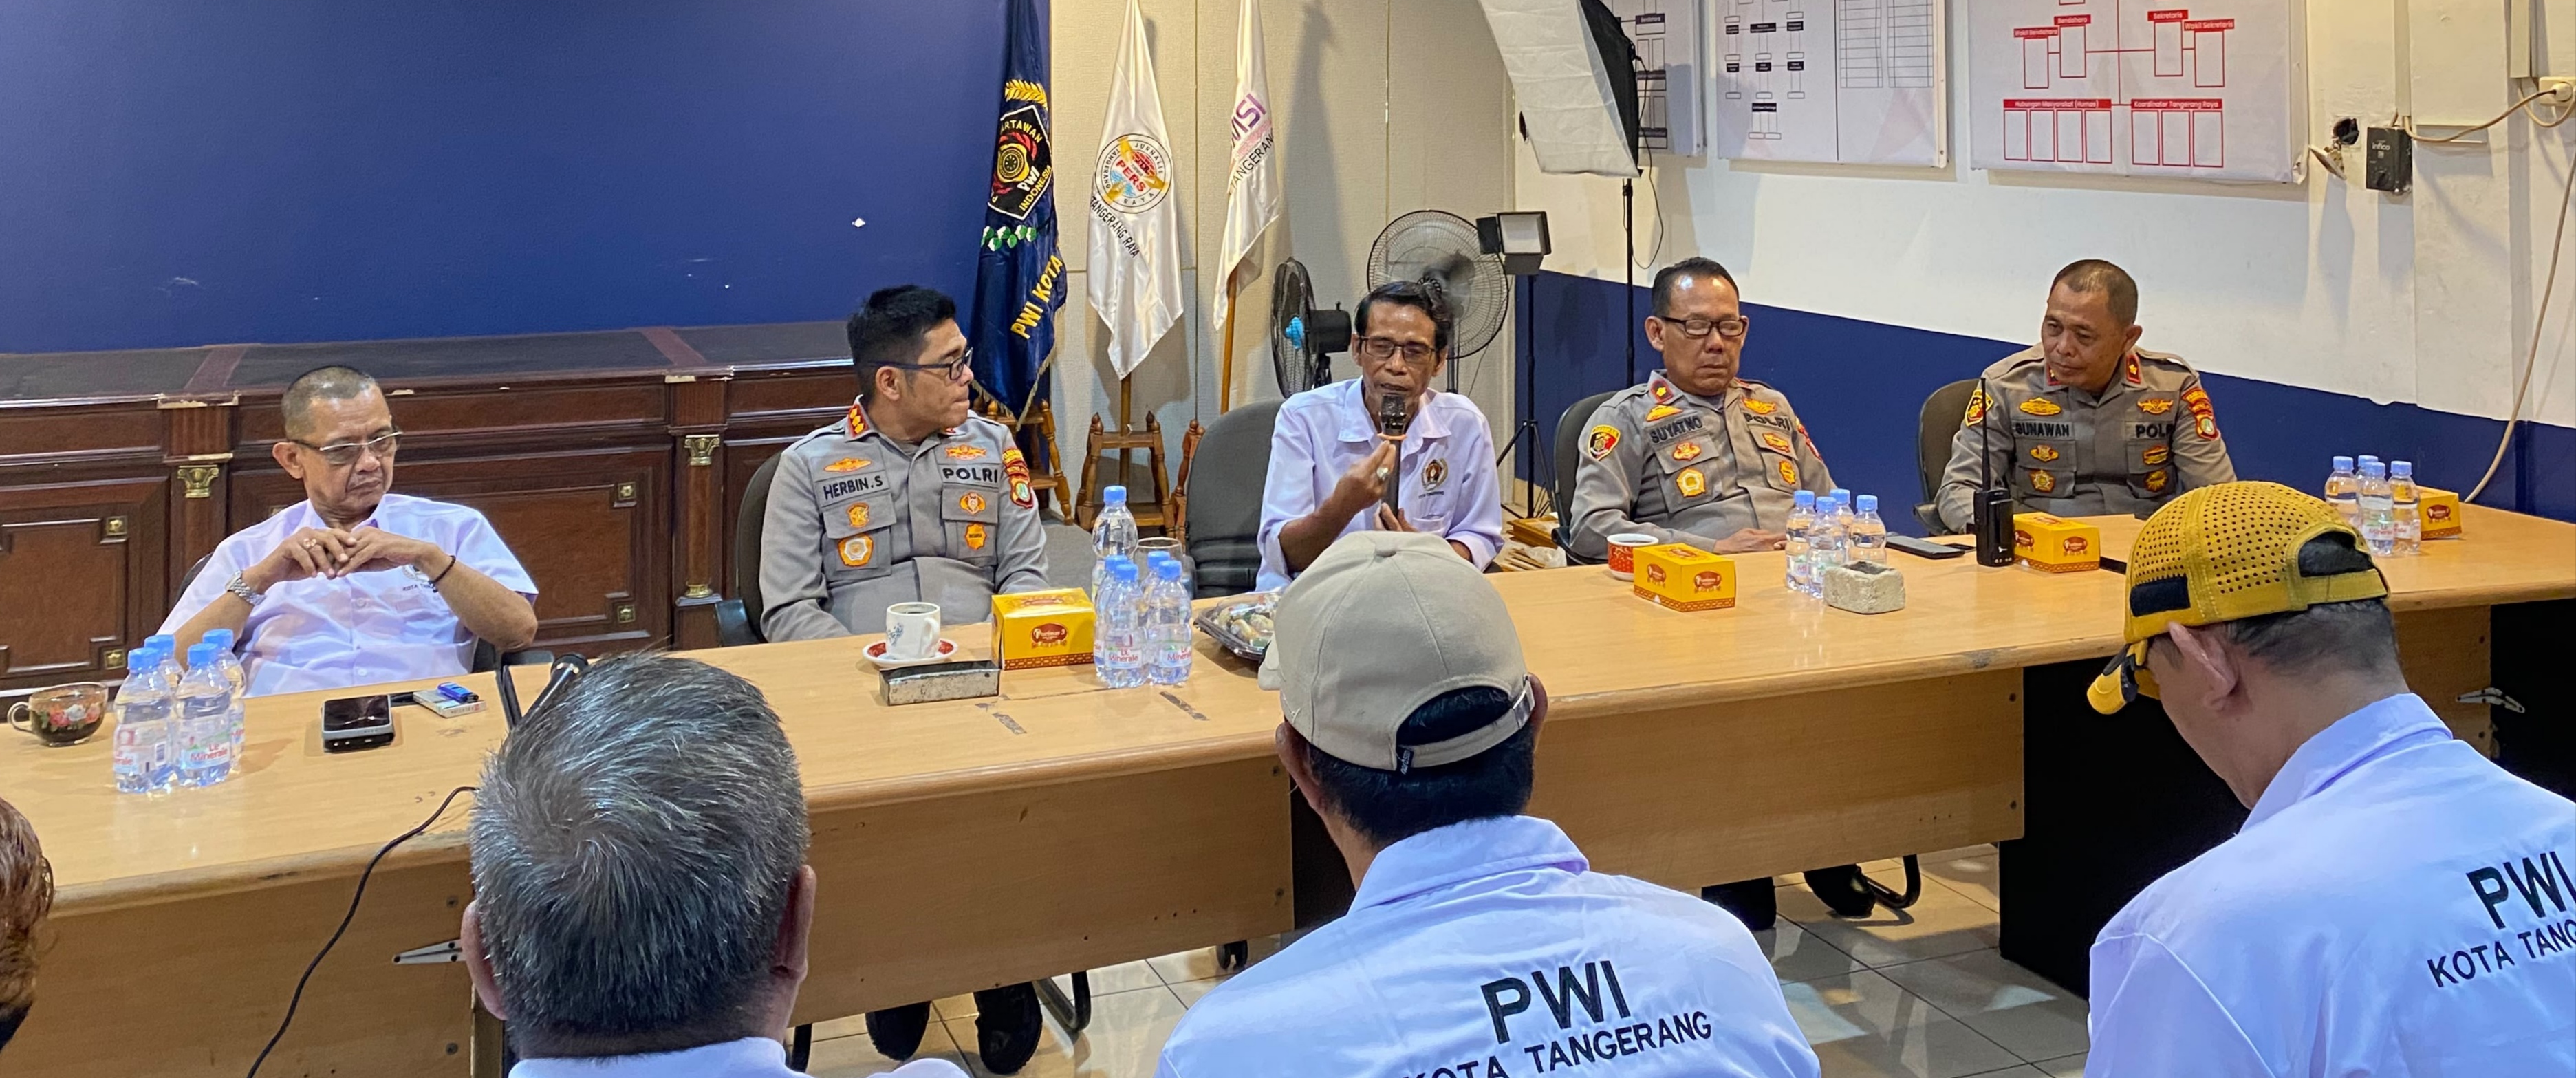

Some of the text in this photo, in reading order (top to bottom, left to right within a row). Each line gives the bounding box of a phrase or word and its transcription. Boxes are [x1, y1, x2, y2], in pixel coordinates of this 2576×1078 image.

[1017, 166, 1040, 191] PWI
[1019, 165, 1052, 211] INDONESIA
[1116, 160, 1146, 192] PERS
[1124, 193, 1154, 205] RAYA
[1090, 196, 1140, 258] TANGERANG RAYA
[1010, 255, 1063, 339] PWI KOTA
[1651, 415, 1703, 444] SUYATNO
[1743, 413, 1791, 431] POLRI
[942, 468, 997, 483] POLRI
[1108, 653, 1138, 662] Minerale
[190, 748, 228, 762] Minerale
[208, 743, 219, 752] Le
[2465, 851, 2576, 930] PWI
[2427, 940, 2515, 988] KOTA
[1480, 960, 1630, 1044] PWI
[1524, 1011, 1712, 1074] TANGERANG
